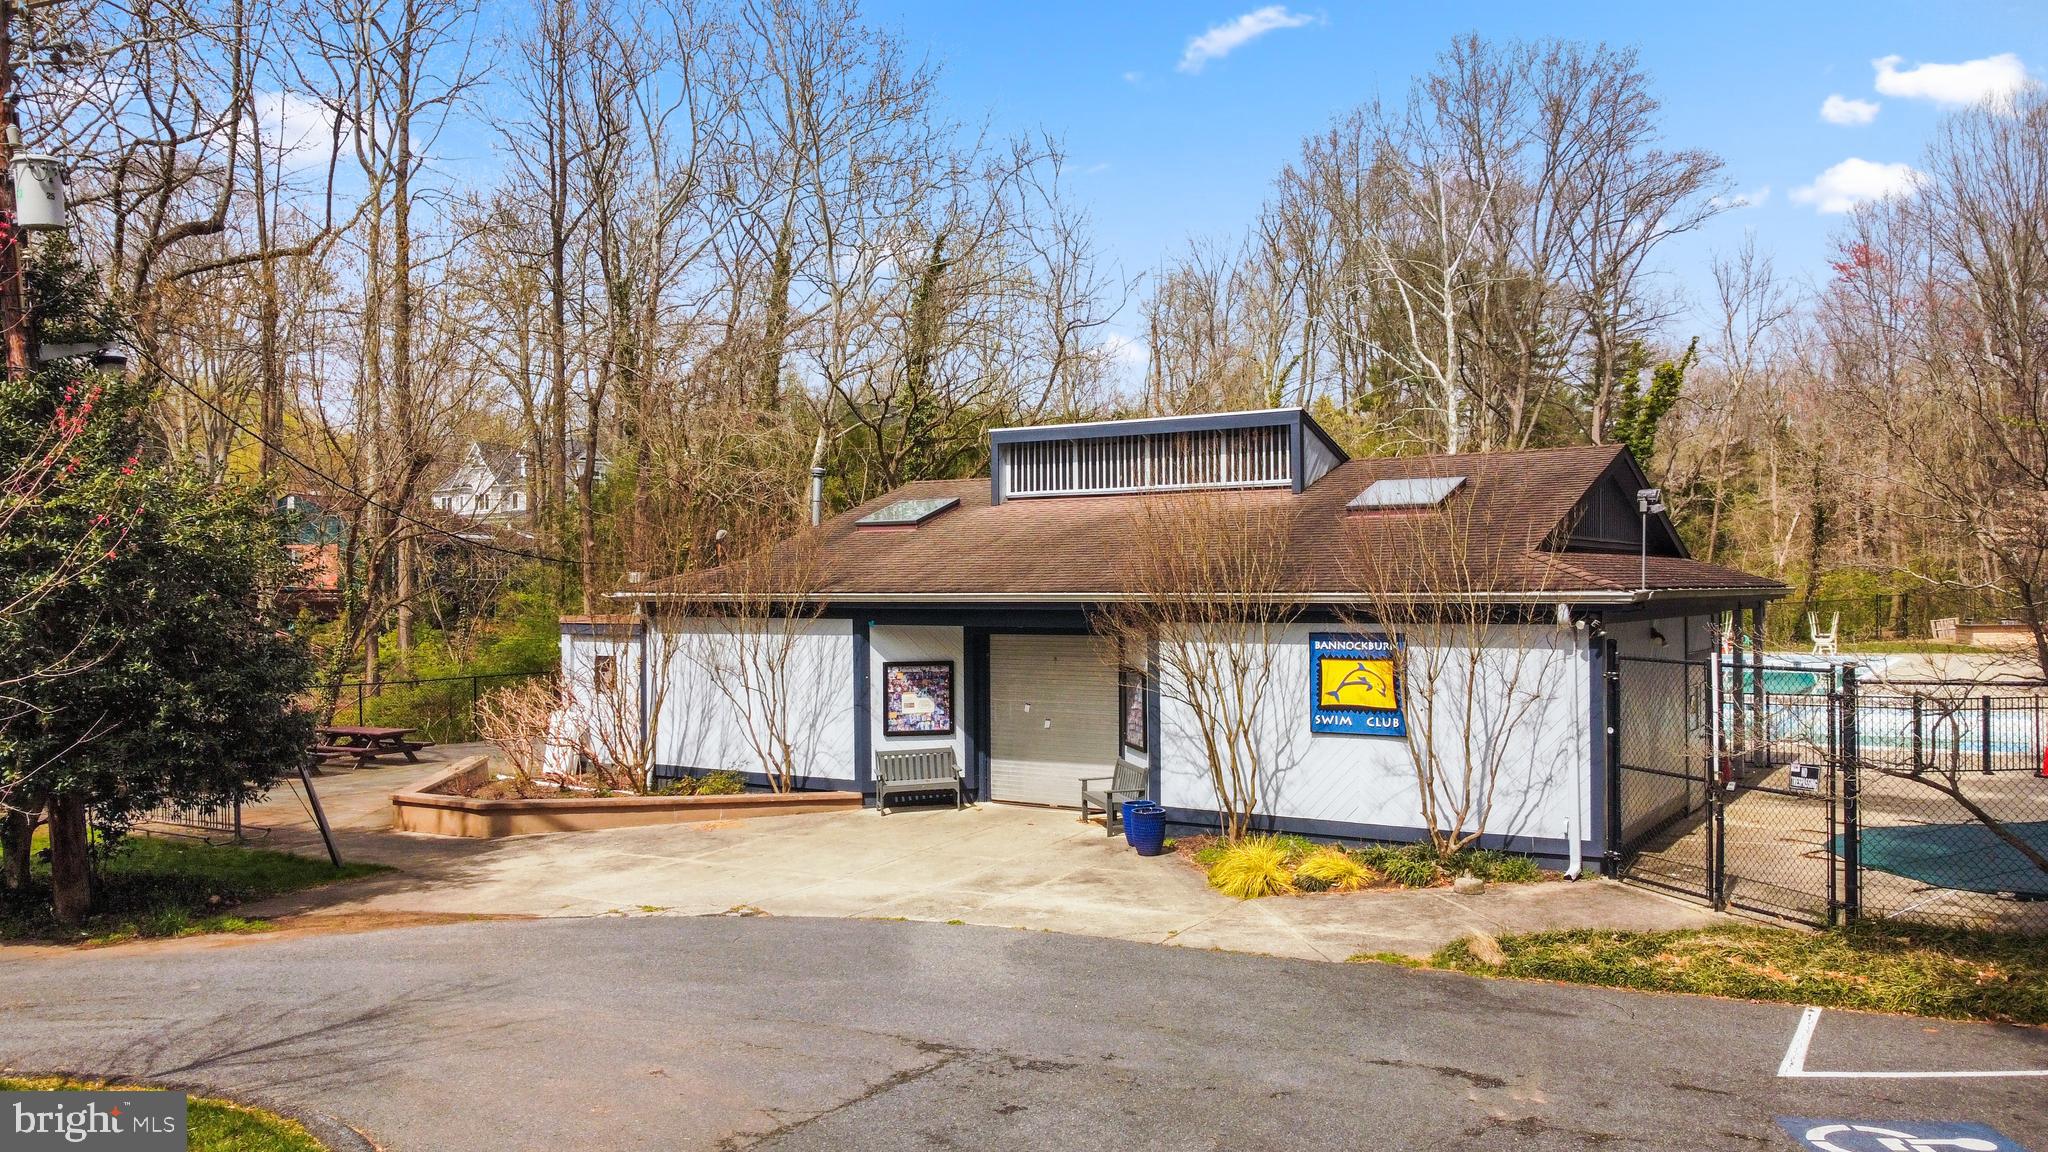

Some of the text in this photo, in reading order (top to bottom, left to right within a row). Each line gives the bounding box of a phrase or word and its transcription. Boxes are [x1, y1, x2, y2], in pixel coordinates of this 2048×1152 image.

[1315, 715, 1400, 728] SWIM CLUB
[1791, 776, 1818, 789] TRESPASSING
